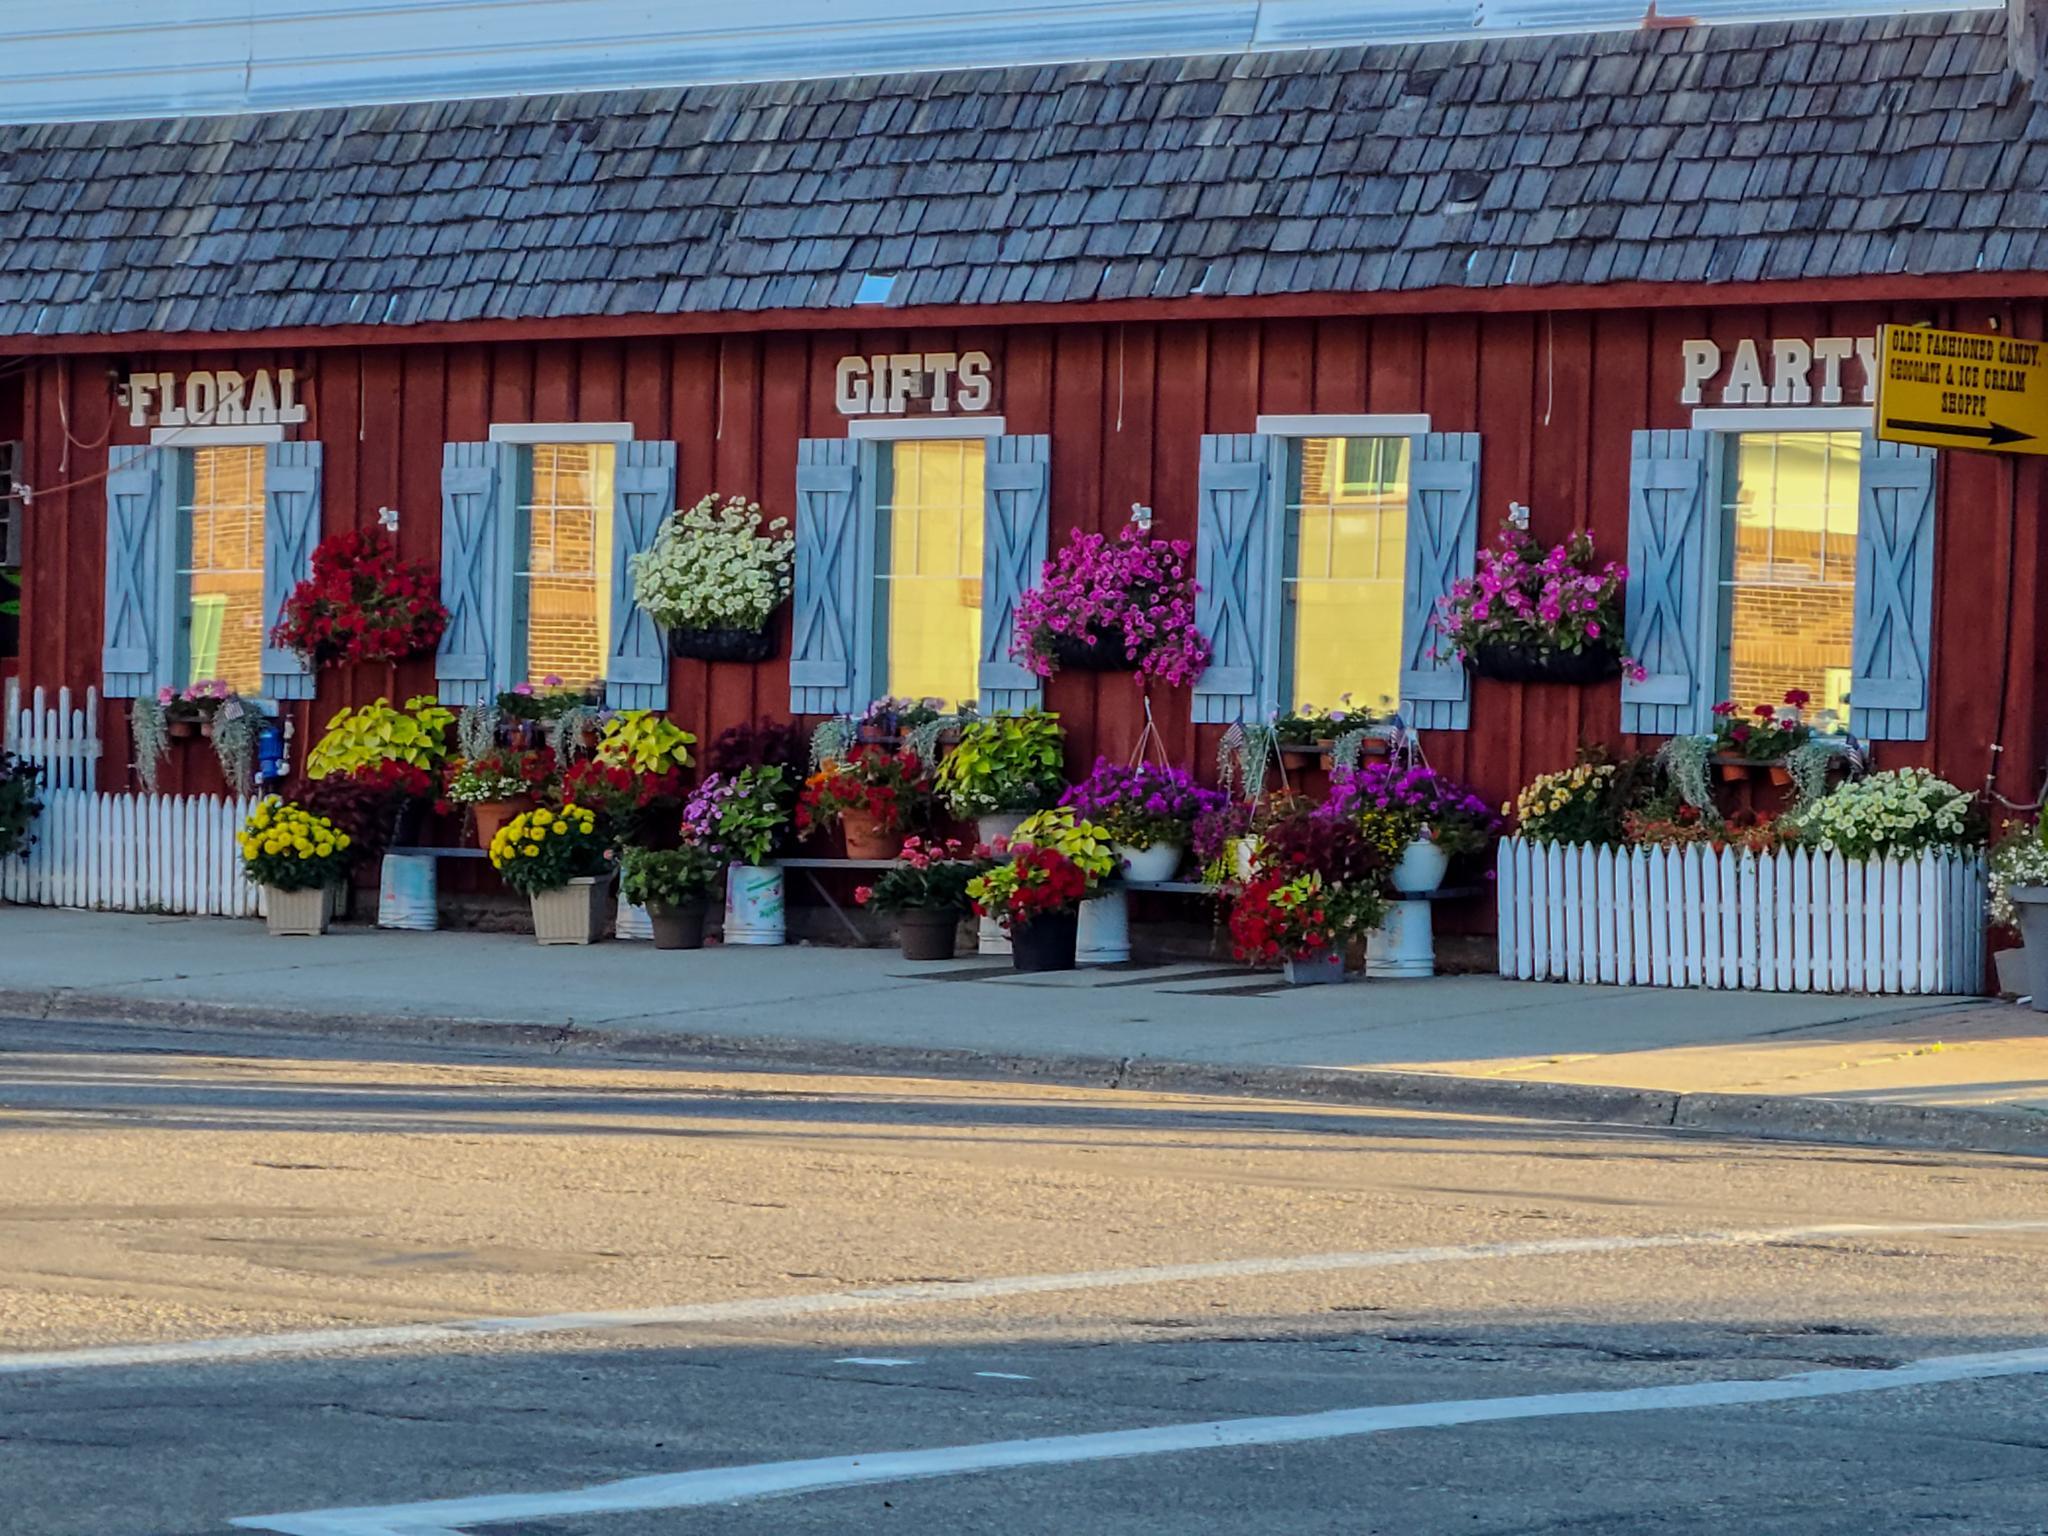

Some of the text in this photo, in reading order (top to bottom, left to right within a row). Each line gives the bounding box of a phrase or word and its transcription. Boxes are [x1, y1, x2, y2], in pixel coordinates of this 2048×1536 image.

[1892, 330, 1922, 354] OLDE
[1927, 333, 1994, 361] FASHIONED
[836, 351, 992, 414] GIFTS
[1946, 364, 1954, 385] &
[1960, 365, 1979, 388] ICE
[1984, 368, 2026, 392] CREAM
[129, 369, 307, 426] FLORAL
[1941, 391, 1987, 416] SHOPPE
